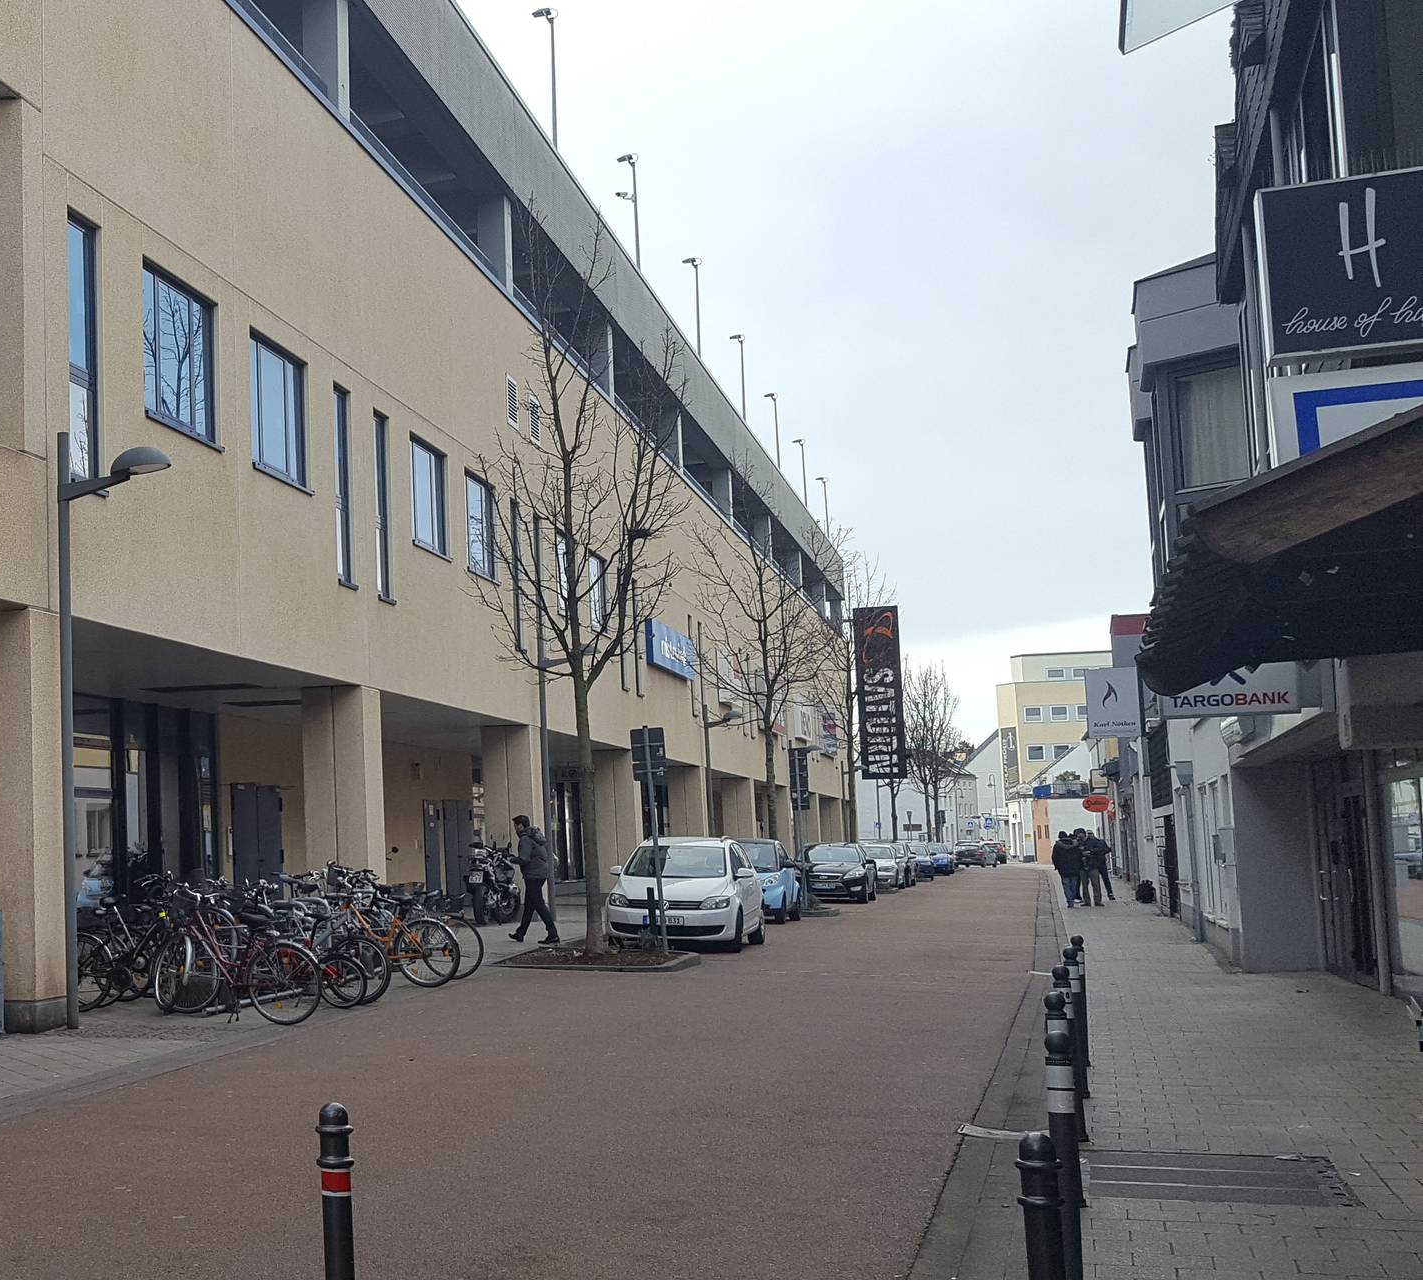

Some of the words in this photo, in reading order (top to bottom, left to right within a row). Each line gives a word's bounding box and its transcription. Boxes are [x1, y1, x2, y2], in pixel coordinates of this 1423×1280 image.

[1338, 187, 1387, 288] H
[1281, 307, 1348, 335] house
[1354, 296, 1392, 338] of
[863, 667, 899, 774] SATURN
[1170, 691, 1290, 709] TARGOBANK
